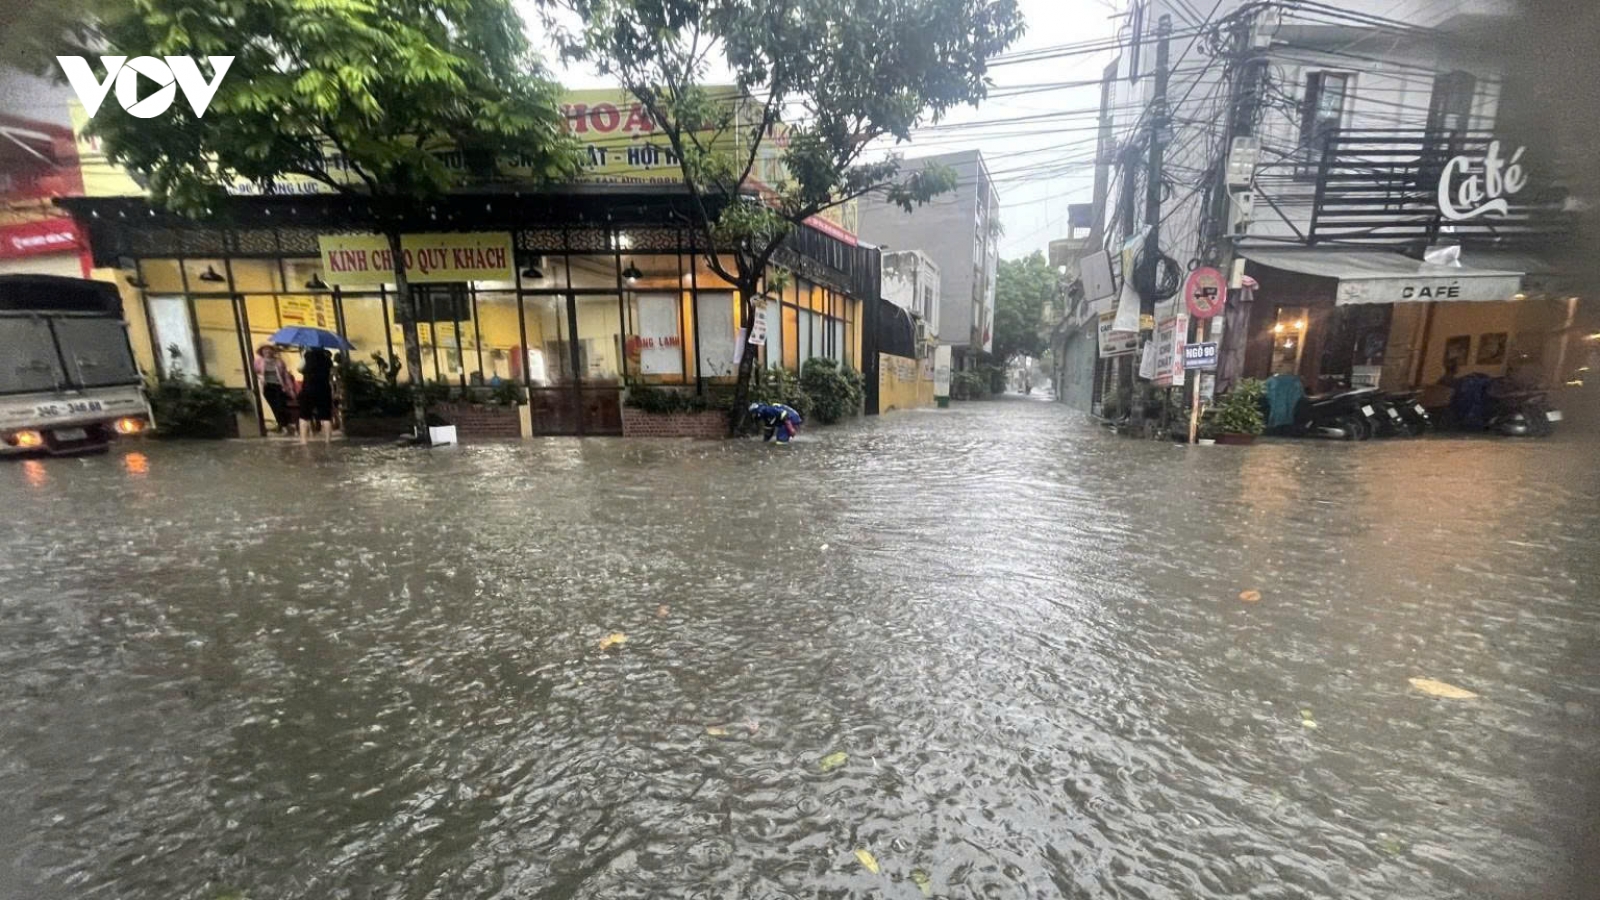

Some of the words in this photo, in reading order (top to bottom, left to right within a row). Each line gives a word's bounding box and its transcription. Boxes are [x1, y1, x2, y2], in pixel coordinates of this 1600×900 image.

[1438, 140, 1527, 220] Café
[372, 249, 413, 271] CHO
[1402, 281, 1460, 298] CAFÉ
